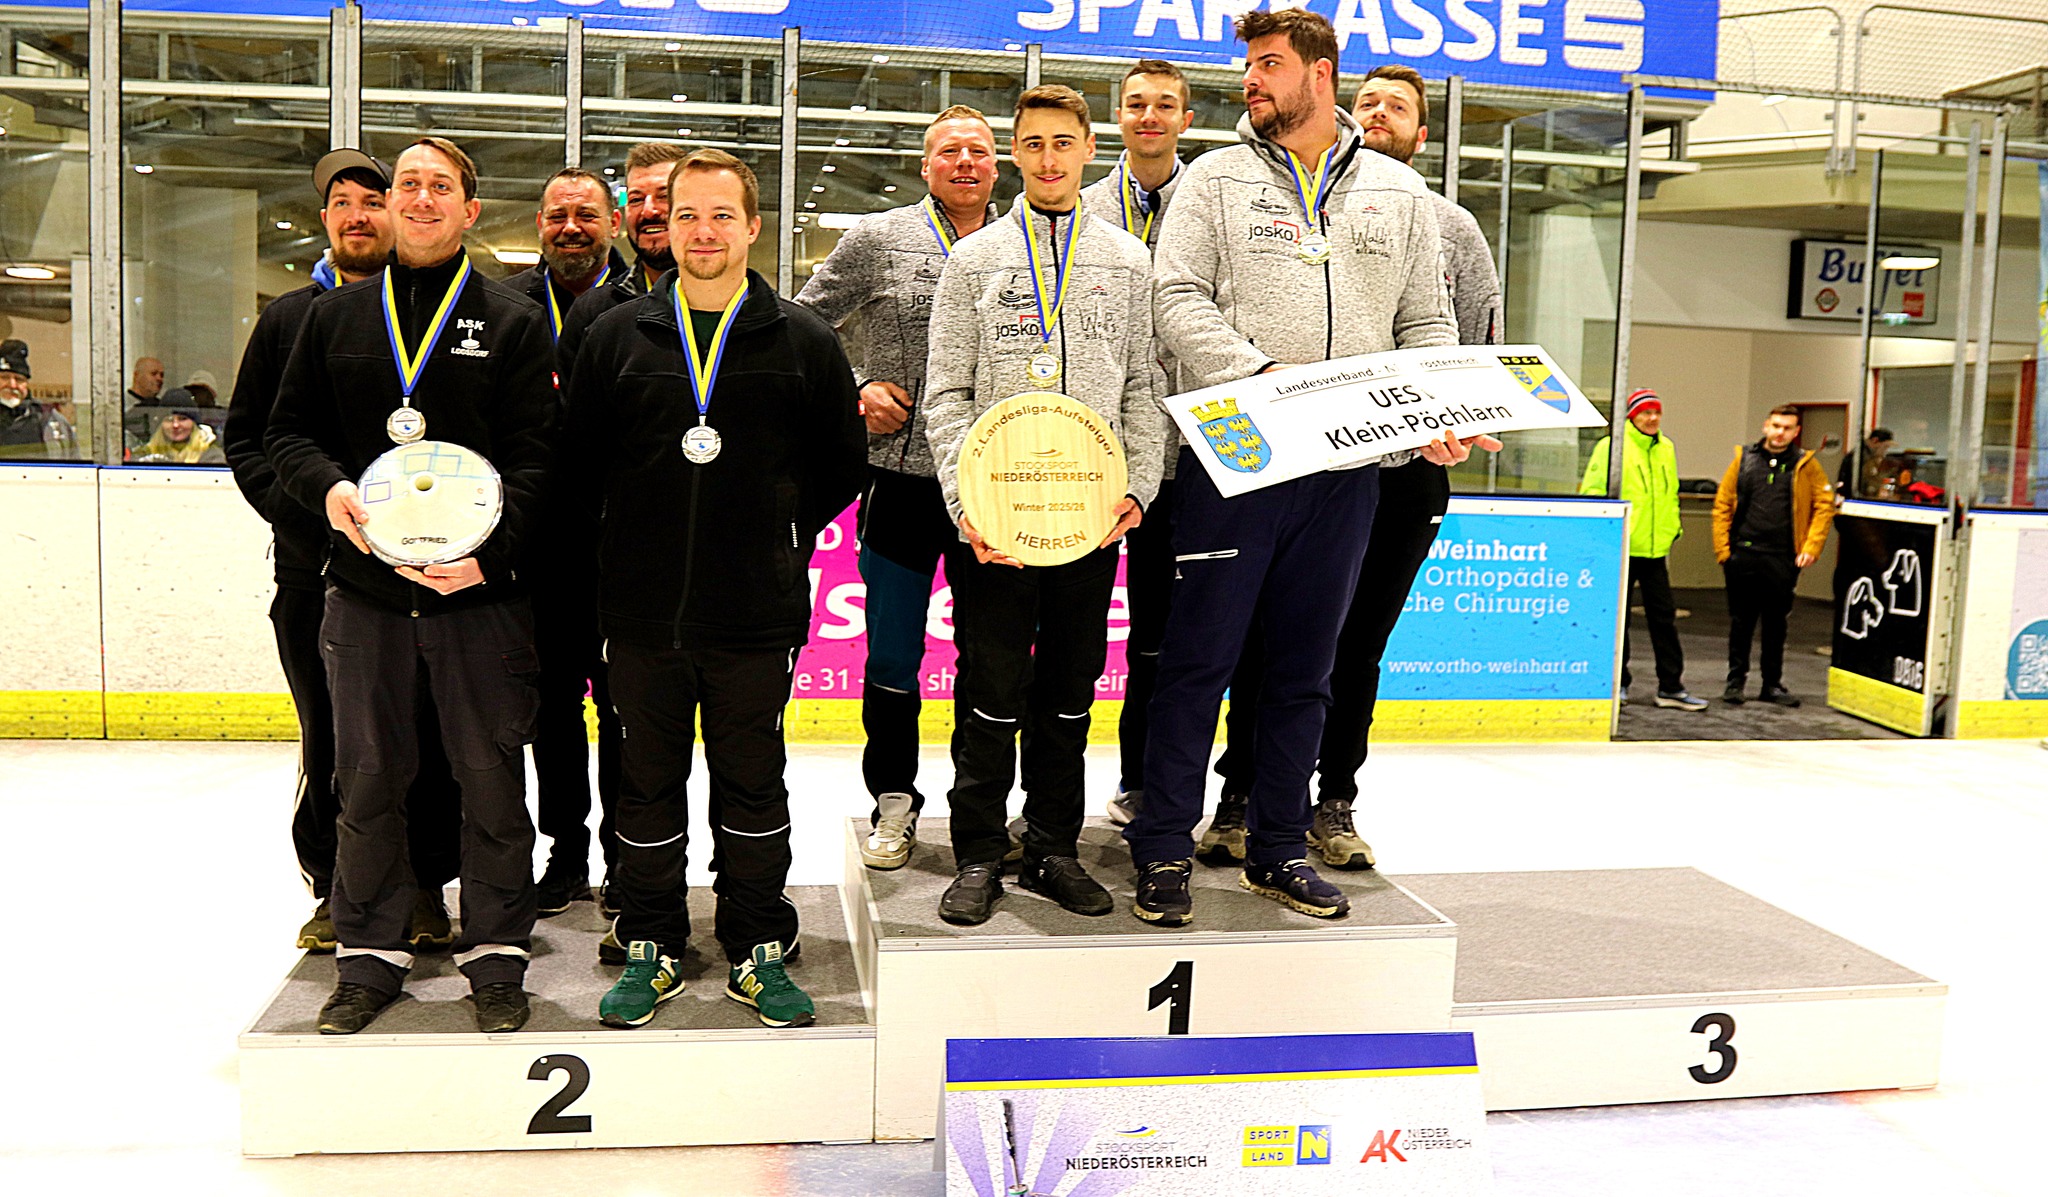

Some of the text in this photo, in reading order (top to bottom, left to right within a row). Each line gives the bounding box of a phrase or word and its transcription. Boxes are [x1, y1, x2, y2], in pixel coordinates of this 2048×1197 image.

[1248, 224, 1293, 241] josko
[911, 292, 935, 308] jos
[456, 318, 486, 331] ASK
[995, 322, 1040, 341] josko
[1276, 367, 1375, 396] Landesverband
[1324, 402, 1513, 450] Klein-Pöchlarn
[1014, 461, 1080, 470] STOCKSPORT
[990, 470, 1104, 482] NIEDERÖSTERREICH
[1012, 503, 1086, 512] Winter 2025/26
[1015, 529, 1088, 550] HERREN
[1427, 539, 1548, 561] Weinhart
[1425, 566, 1595, 592] Orthopädie &
[1454, 592, 1571, 618] Chirurgie
[1387, 658, 1589, 674] www.ortho-weinhart.at
[819, 668, 849, 690] 31
[1147, 961, 1194, 1035] 1
[1687, 1012, 1738, 1084] 3
[526, 1054, 592, 1134] 2
[1249, 1130, 1290, 1140] SPORT
[1407, 1128, 1450, 1139] NIEDER
[1096, 1141, 1177, 1153] STOCKSPORT
[1359, 1129, 1408, 1163] AK
[1402, 1139, 1473, 1150] ÖSTERREICH
[1066, 1155, 1207, 1170] NIEDERÖSTERREICH
[1251, 1151, 1285, 1162] LAND
